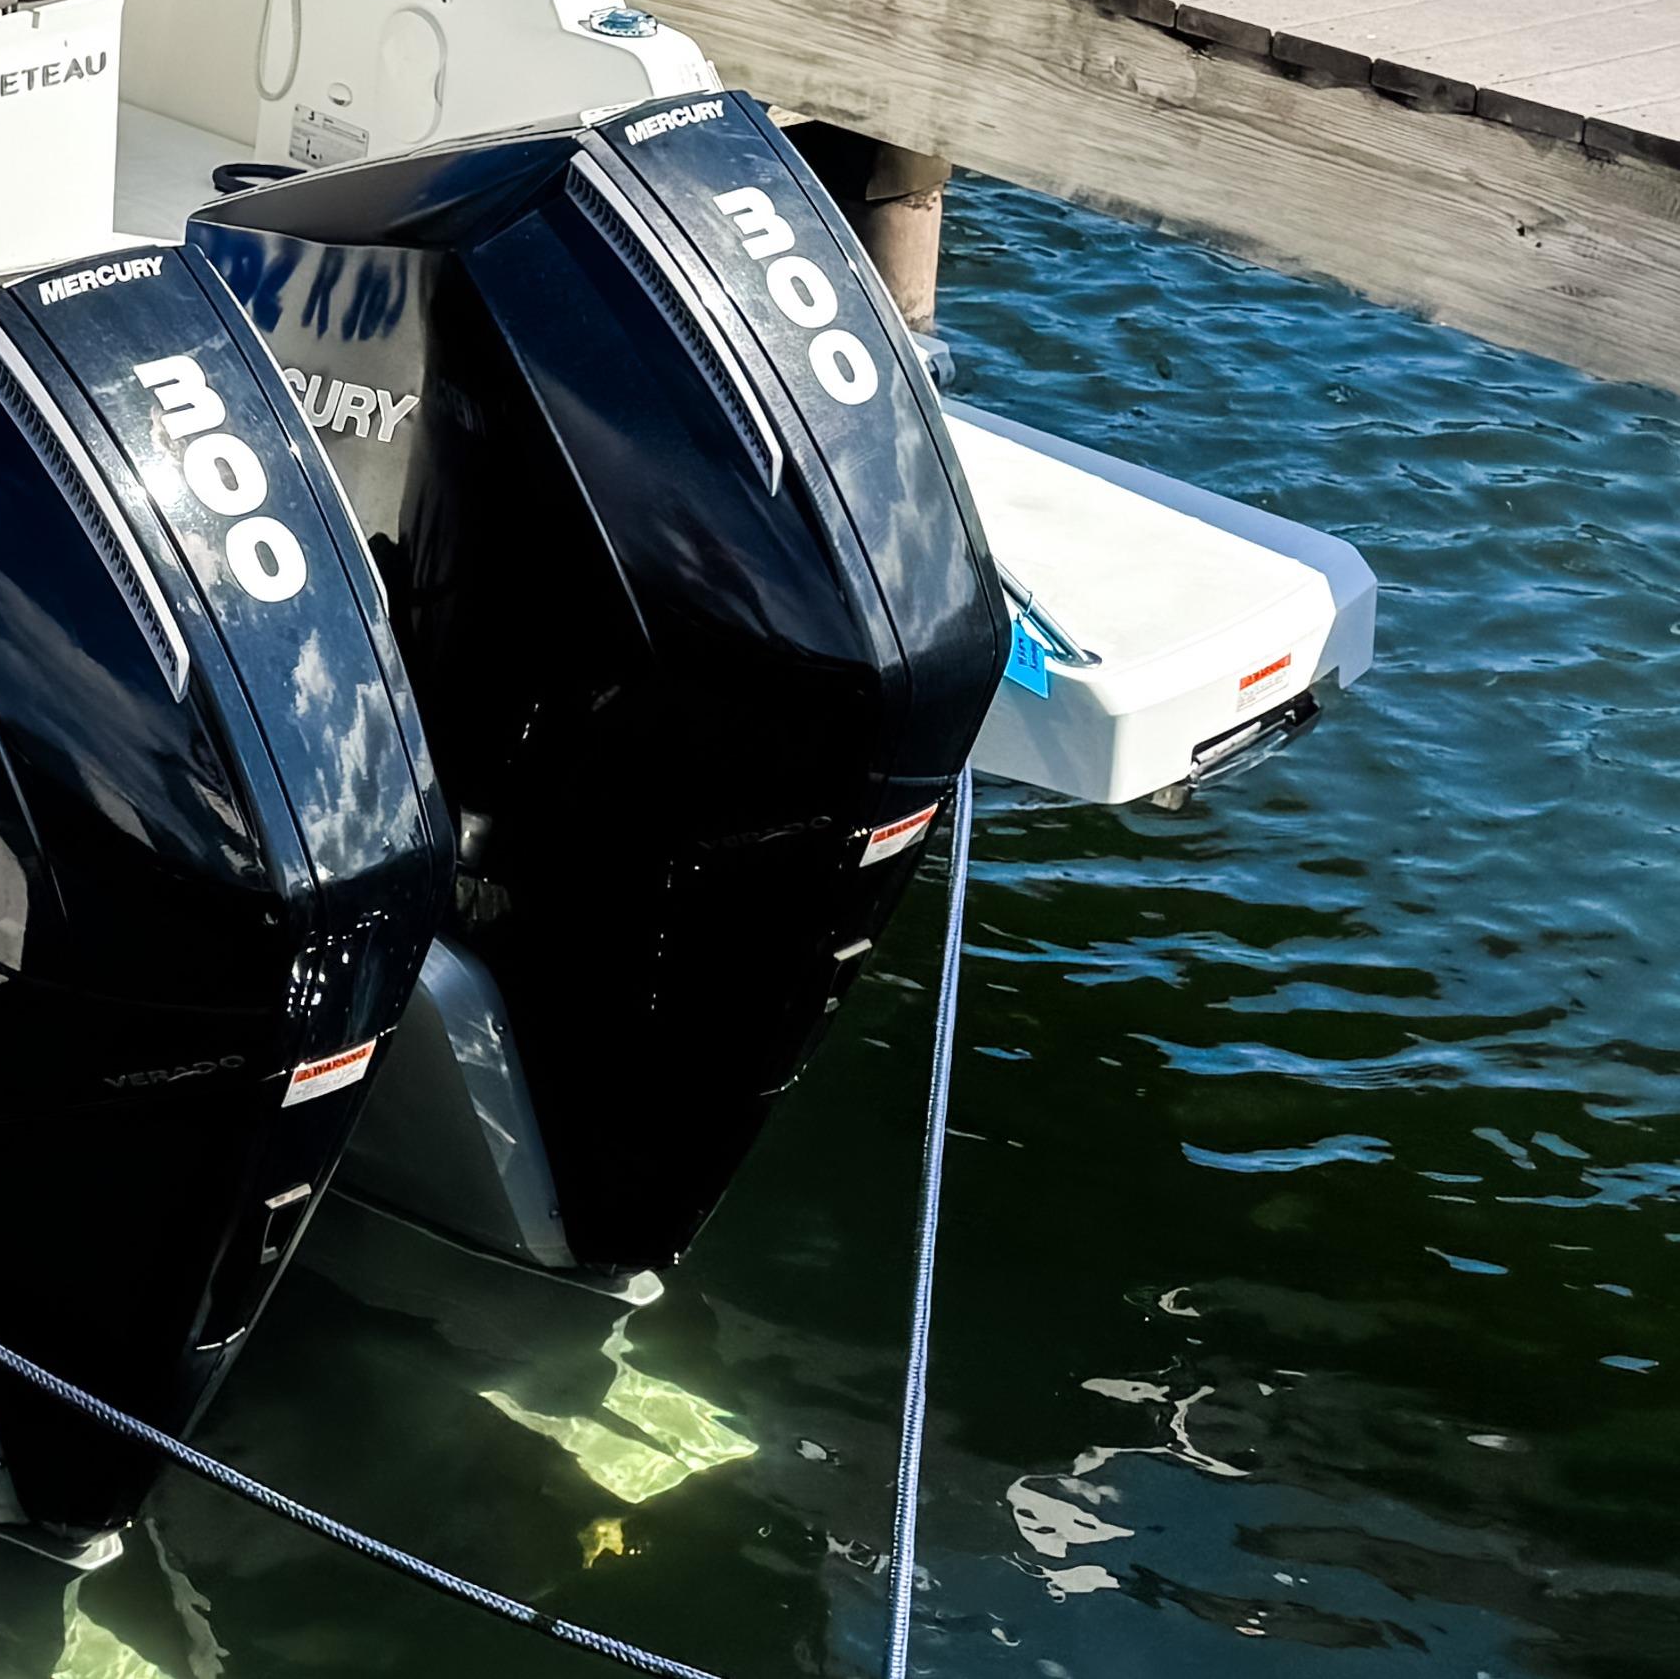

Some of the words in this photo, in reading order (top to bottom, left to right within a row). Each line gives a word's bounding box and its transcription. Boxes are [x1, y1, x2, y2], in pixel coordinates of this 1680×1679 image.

[624, 100, 725, 146] MERCURY
[37, 255, 164, 305] MERCURY
[712, 186, 879, 406] 300
[132, 354, 308, 603] 300
